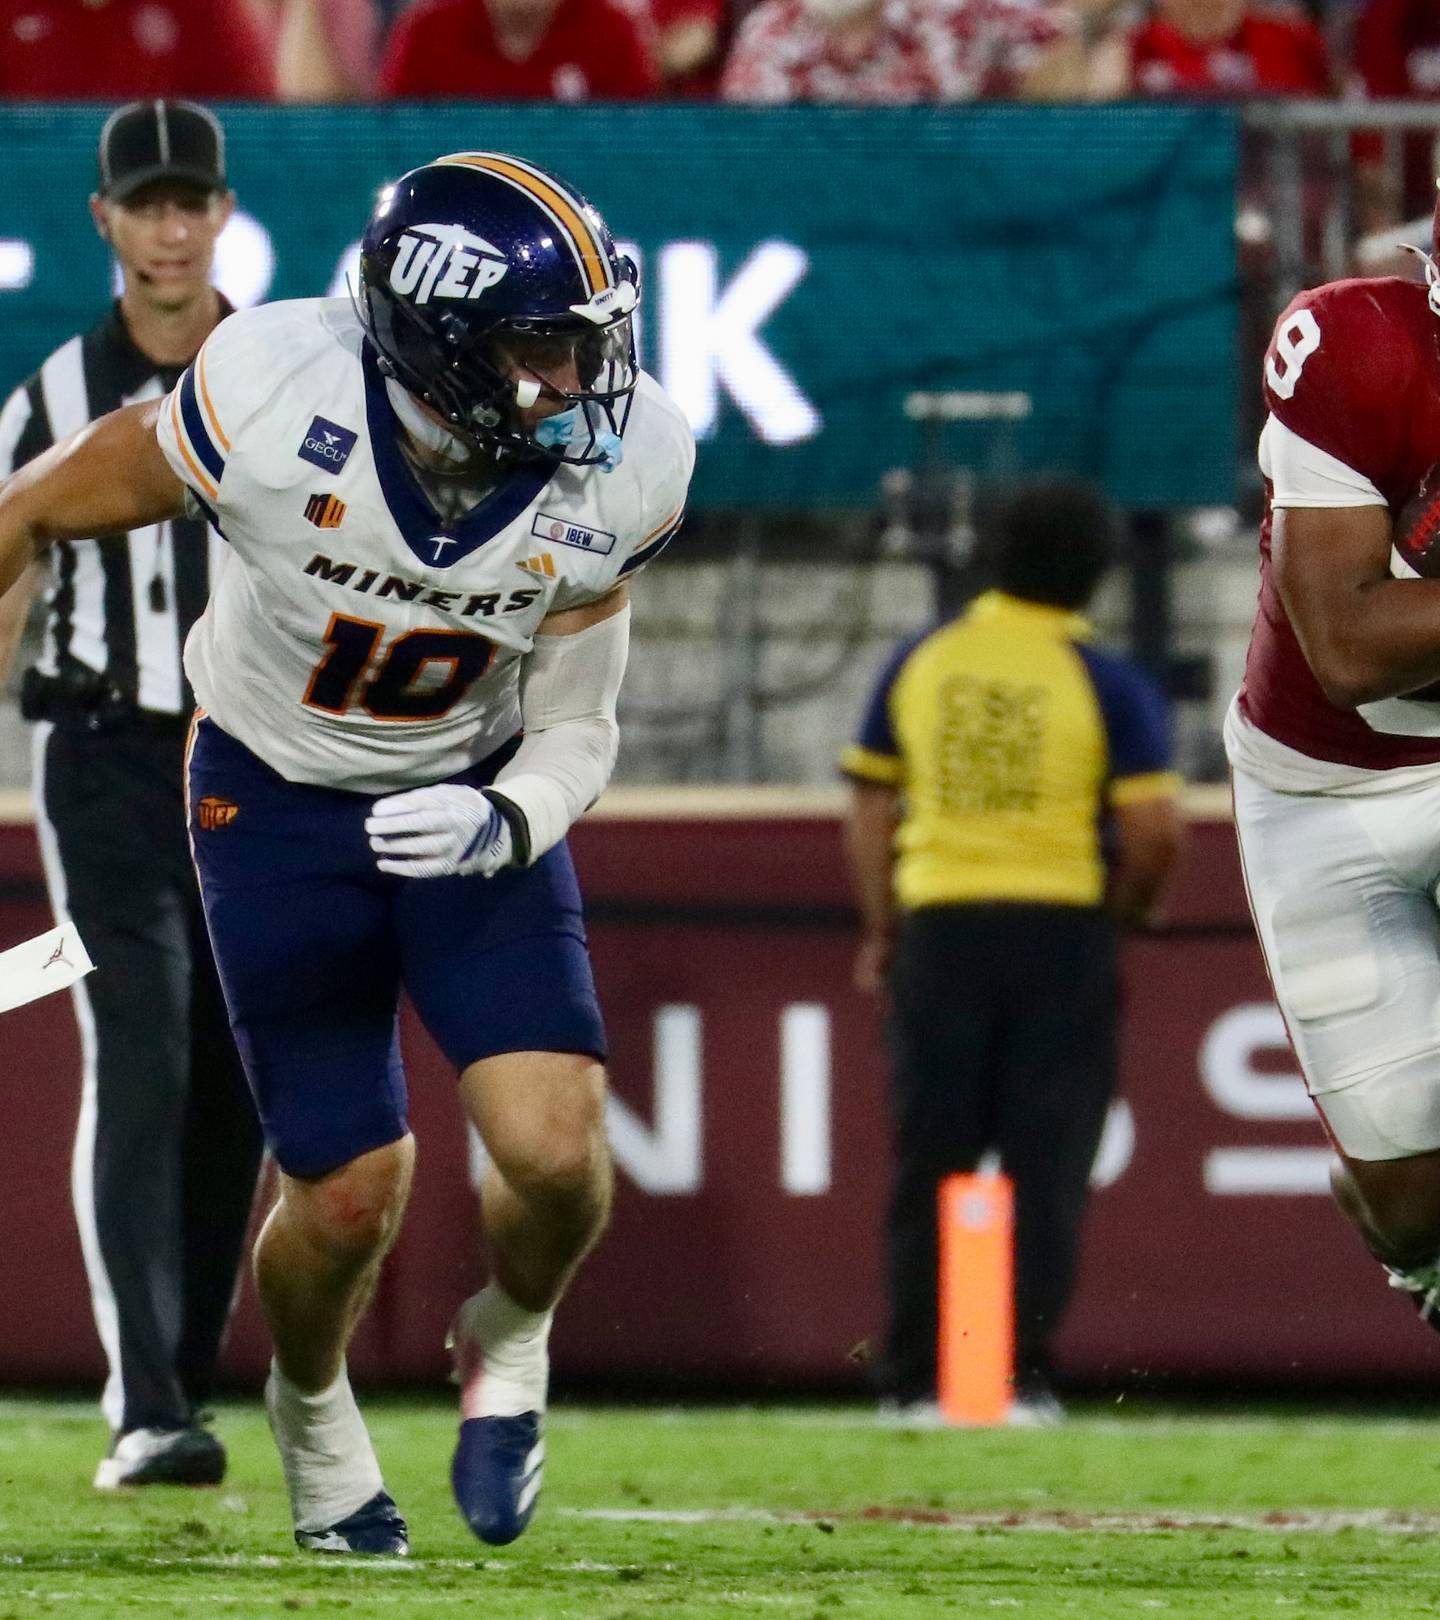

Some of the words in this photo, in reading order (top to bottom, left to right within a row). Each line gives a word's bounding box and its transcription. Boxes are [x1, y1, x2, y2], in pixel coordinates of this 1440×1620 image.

[390, 223, 510, 304] UTEP
[1265, 309, 1321, 400] 9
[565, 527, 595, 547] IBEW
[303, 553, 542, 617] MINERS
[302, 612, 500, 722] 10
